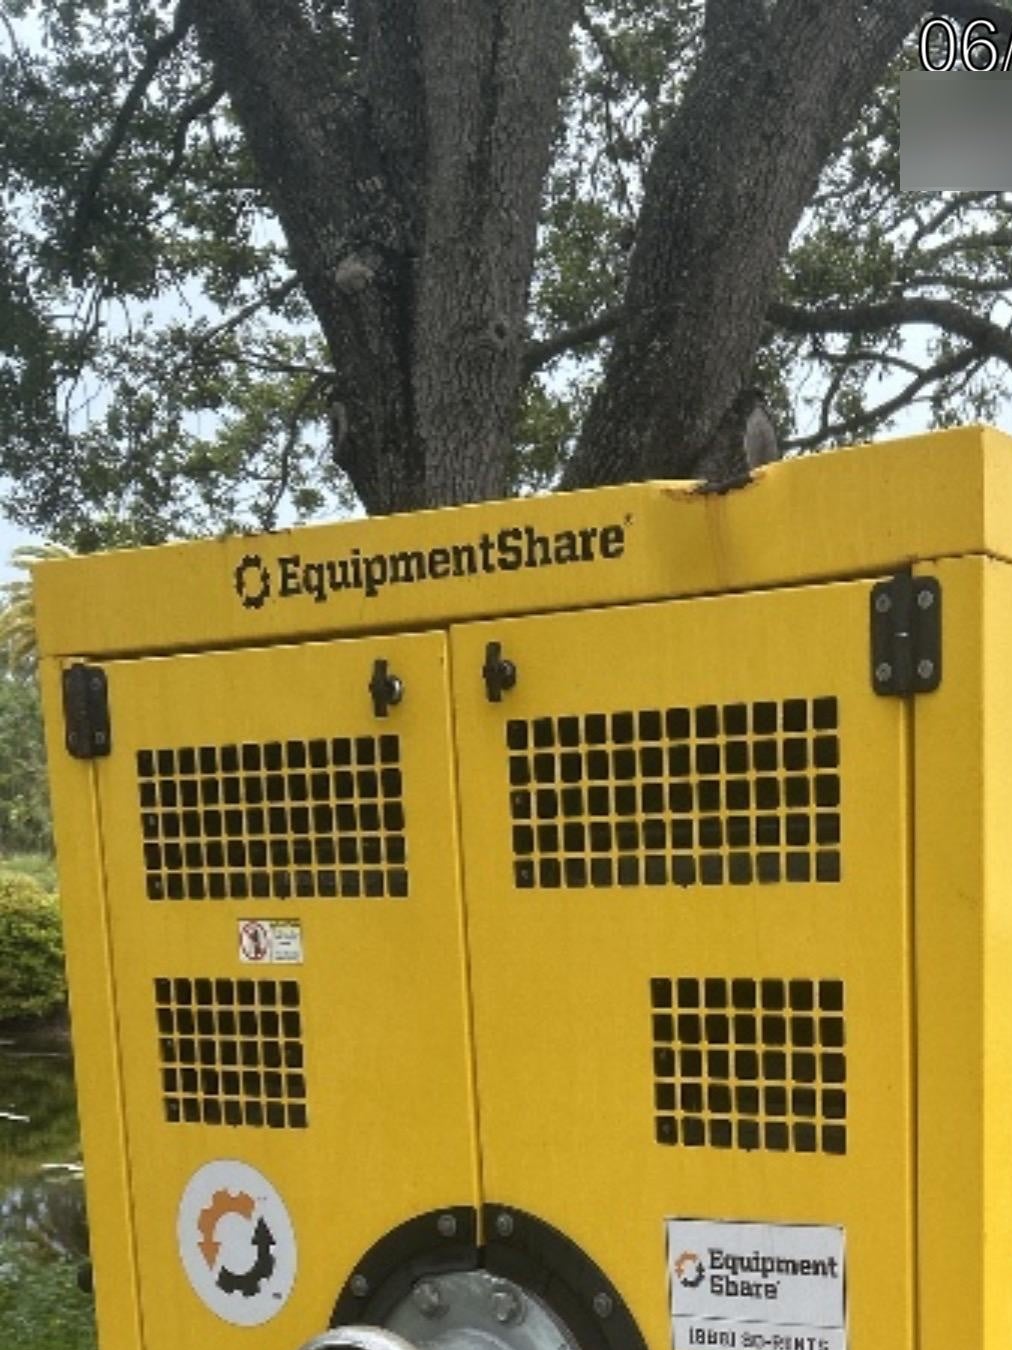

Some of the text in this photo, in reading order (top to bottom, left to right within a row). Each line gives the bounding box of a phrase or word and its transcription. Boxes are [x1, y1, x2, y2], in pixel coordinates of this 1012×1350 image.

[277, 522, 626, 602] EquipmentShare
[708, 1247, 839, 1279] Equipment
[710, 1274, 777, 1300] Share
